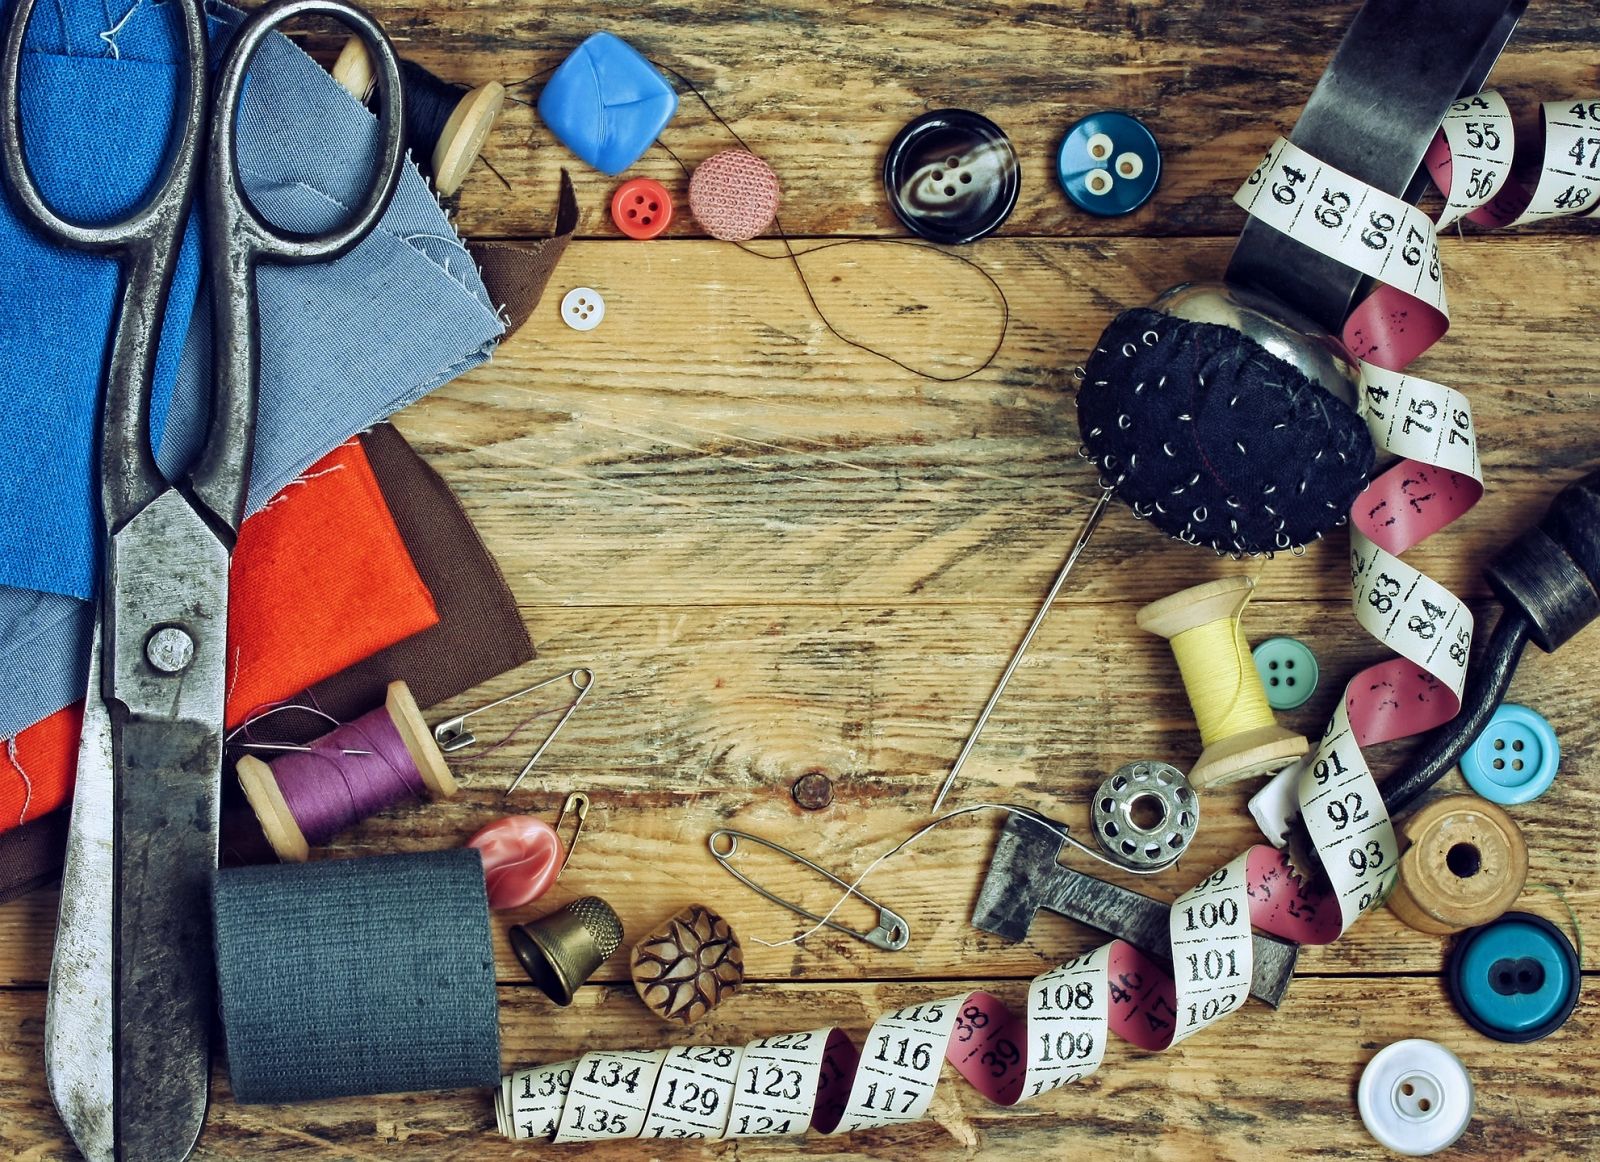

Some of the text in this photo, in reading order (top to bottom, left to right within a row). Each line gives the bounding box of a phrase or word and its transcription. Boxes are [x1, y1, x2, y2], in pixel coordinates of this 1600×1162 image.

[1465, 122, 1500, 151] 55
[1271, 164, 1307, 205] 64
[1465, 168, 1496, 200] 56
[1554, 185, 1592, 208] 48
[1314, 188, 1351, 228] 65
[1361, 211, 1395, 250] 66
[1402, 225, 1424, 266] 67
[1402, 398, 1438, 435] 75
[1449, 408, 1470, 446] 76
[1368, 572, 1401, 614] 83
[1408, 599, 1447, 640] 84
[1449, 627, 1470, 667] 85
[1313, 750, 1348, 786] 91
[1327, 792, 1370, 830] 92
[1348, 840, 1384, 878] 93
[1183, 898, 1238, 931] 100
[1185, 949, 1240, 982] 101
[888, 1004, 943, 1023] 115
[1038, 982, 1094, 1011] 108
[1186, 993, 1237, 1027] 102
[676, 1046, 735, 1068] 128
[874, 1034, 933, 1071] 116
[981, 1039, 1021, 1078] 39
[1039, 1031, 1093, 1062] 109
[520, 1069, 574, 1099] 139
[583, 1059, 641, 1094] 134
[744, 1065, 802, 1100] 123
[662, 1078, 719, 1116] 129
[861, 1082, 920, 1113] 117
[570, 1104, 629, 1134] 135
[735, 1115, 791, 1135] 124
